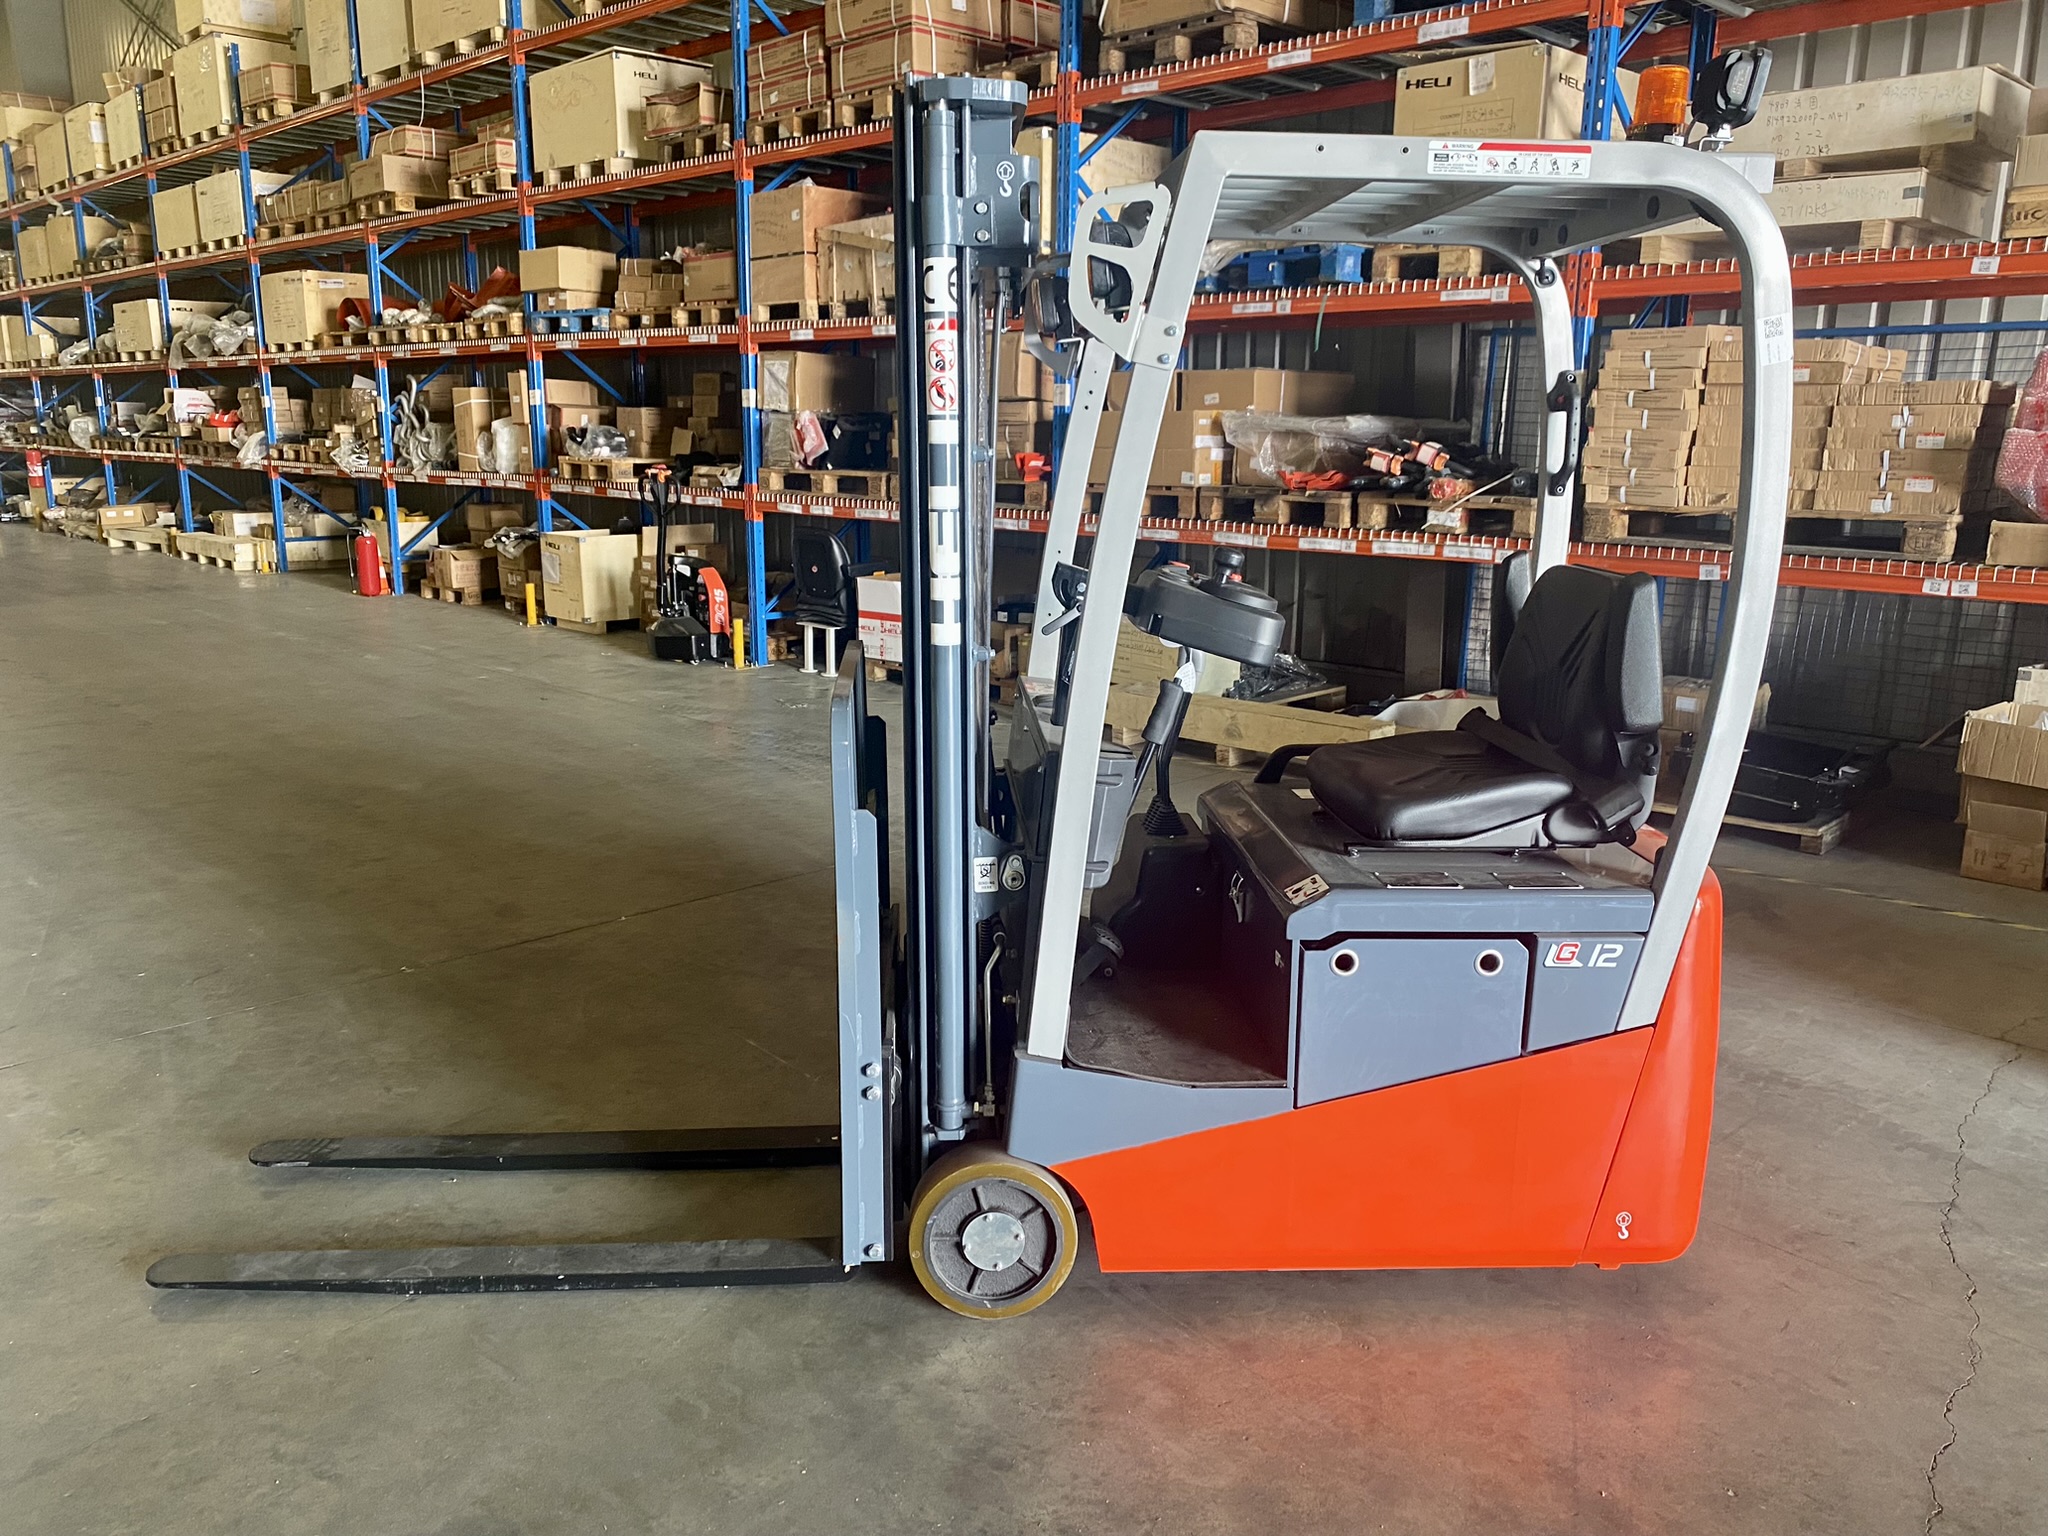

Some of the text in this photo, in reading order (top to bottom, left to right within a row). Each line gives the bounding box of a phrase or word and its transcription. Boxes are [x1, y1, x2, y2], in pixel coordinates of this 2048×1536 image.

[634, 70, 658, 81] HELI
[1406, 76, 1451, 89] HELI
[1587, 943, 1624, 968] 12
